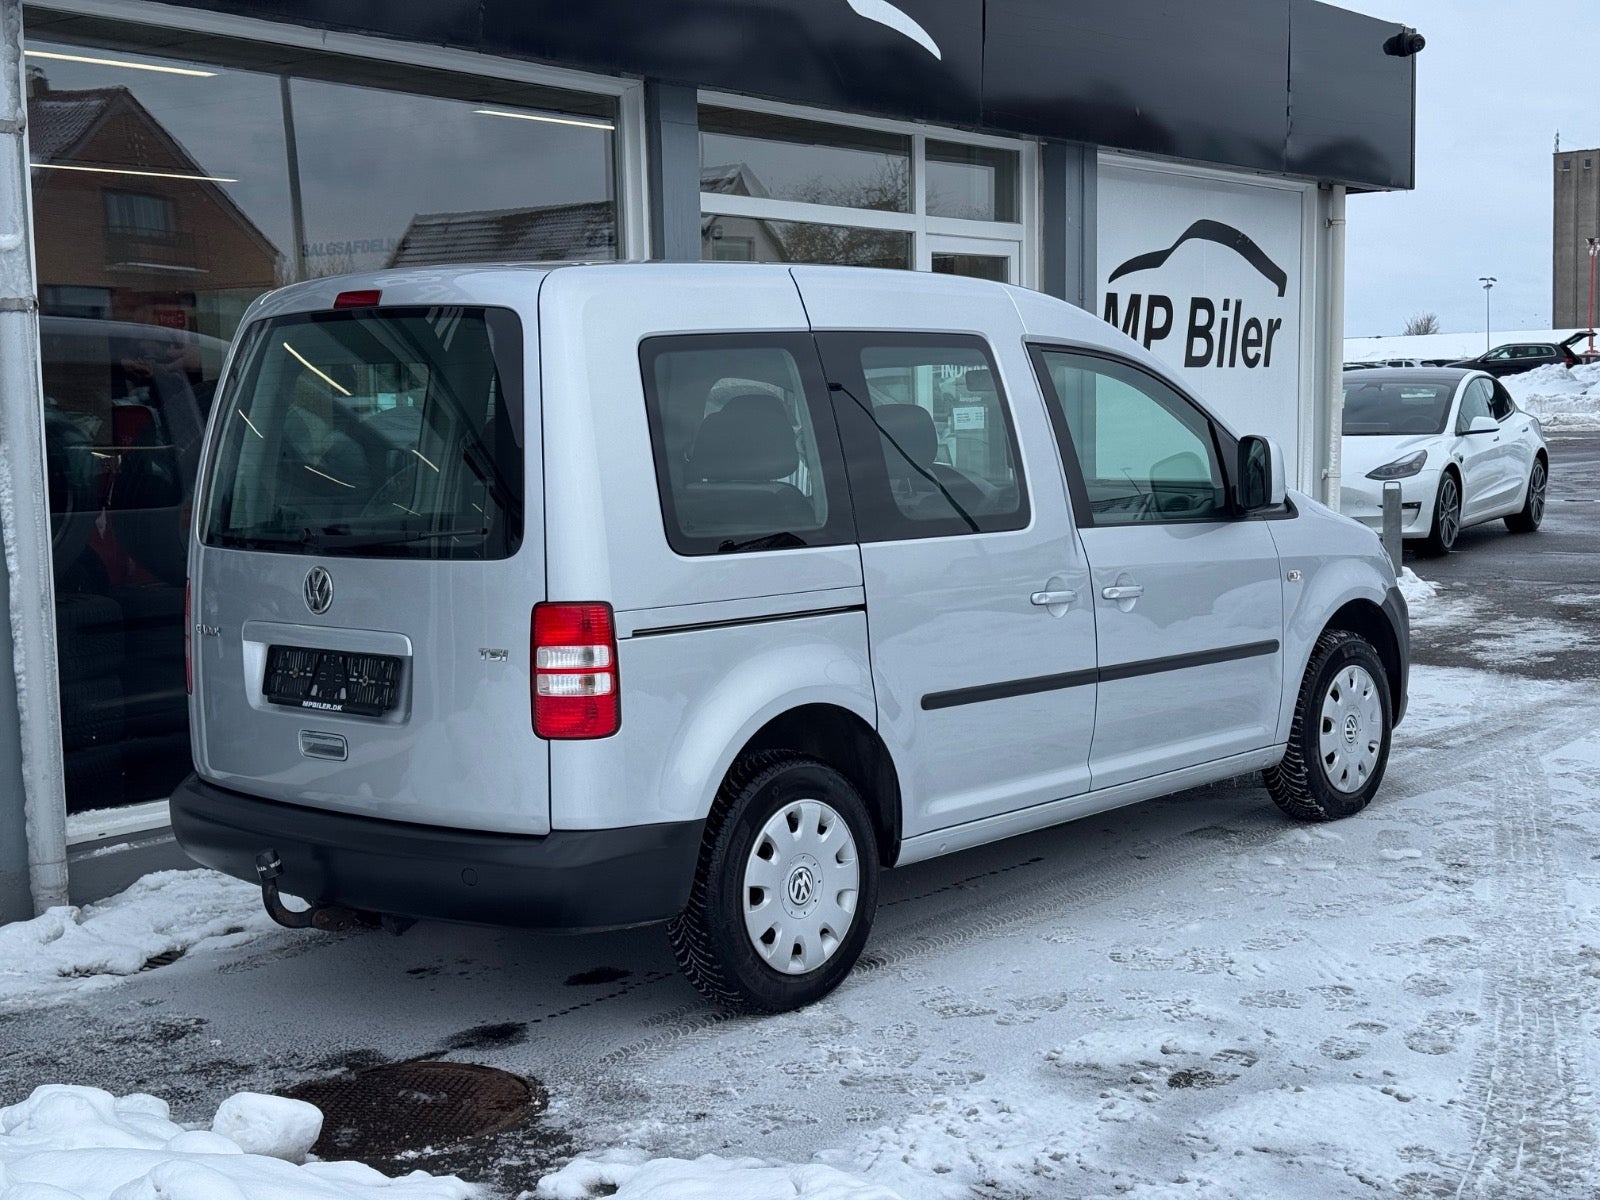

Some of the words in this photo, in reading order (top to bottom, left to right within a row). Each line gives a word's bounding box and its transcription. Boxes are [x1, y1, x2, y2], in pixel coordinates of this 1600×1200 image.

[1104, 292, 1173, 350] MP
[1184, 297, 1282, 368] Biler
[302, 700, 342, 711] MPBILER.DK
